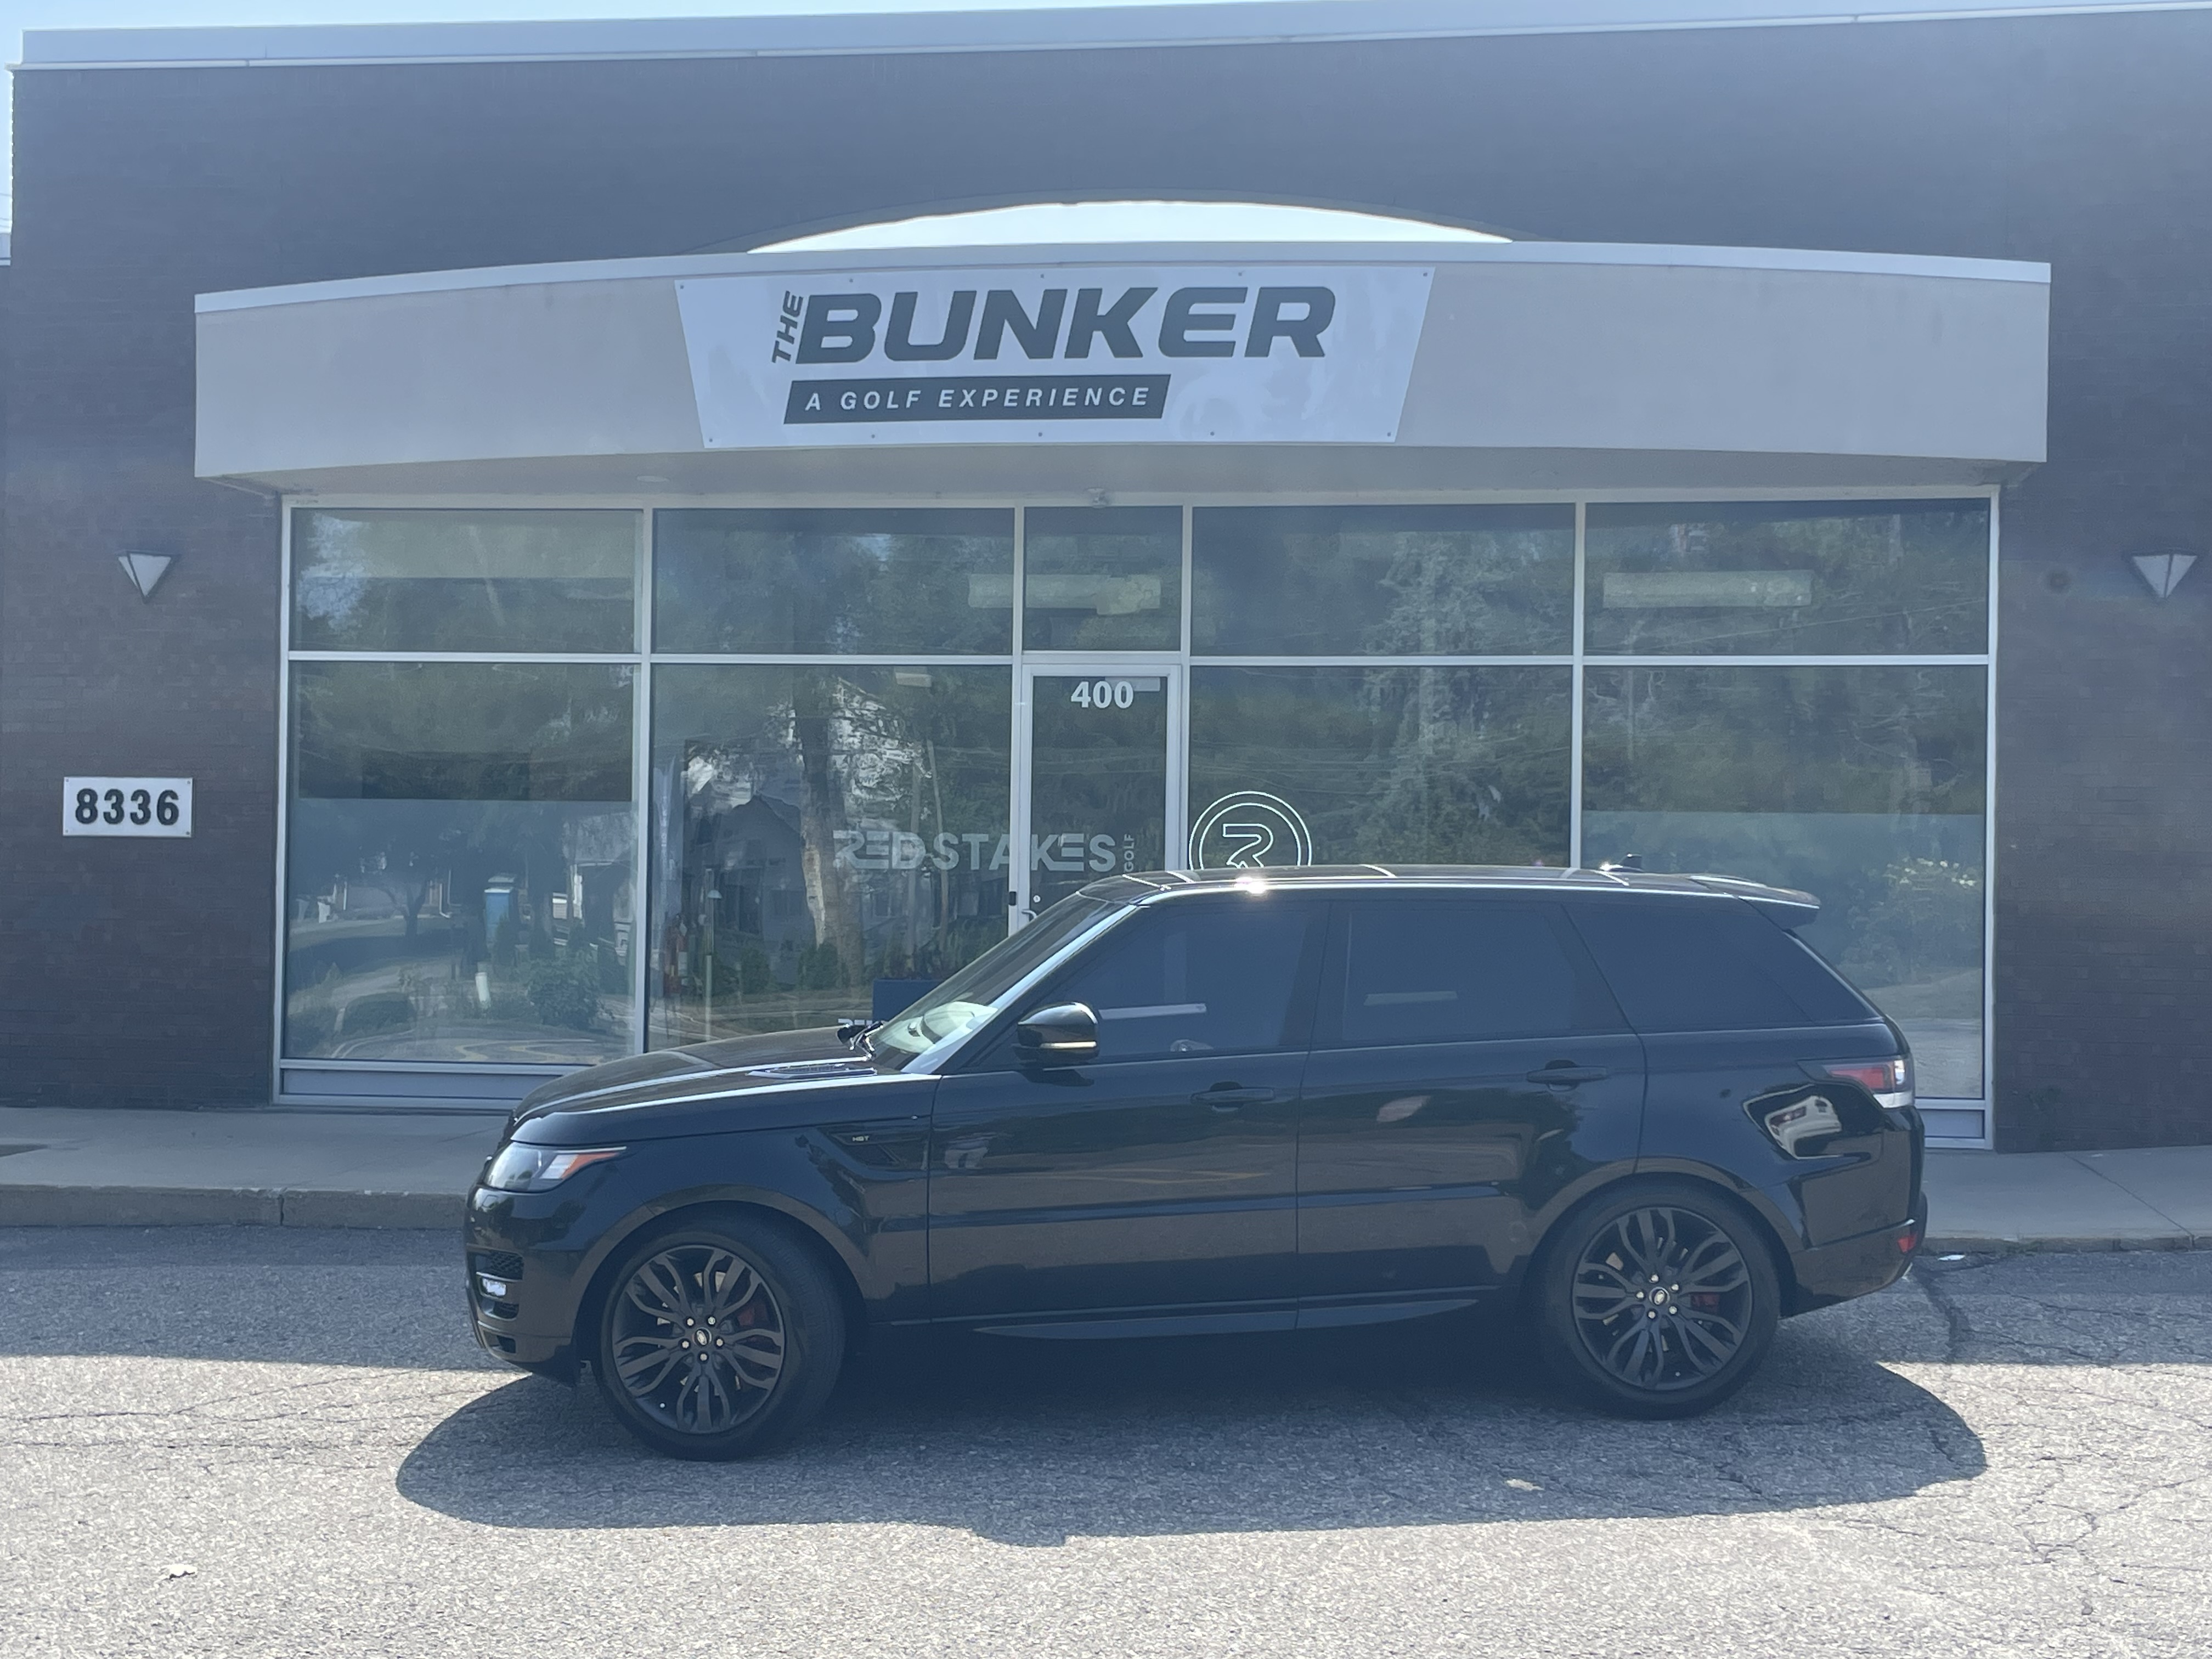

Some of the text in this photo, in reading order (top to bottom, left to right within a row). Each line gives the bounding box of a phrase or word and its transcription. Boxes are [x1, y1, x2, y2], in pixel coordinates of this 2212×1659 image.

[771, 286, 1336, 364] THE BUNKER
[805, 387, 1149, 410] A GOLF EXPERIENCE
[1071, 681, 1134, 708] 400
[75, 788, 179, 825] 8336
[833, 830, 926, 869] RED
[1124, 833, 1135, 872] GOLF
